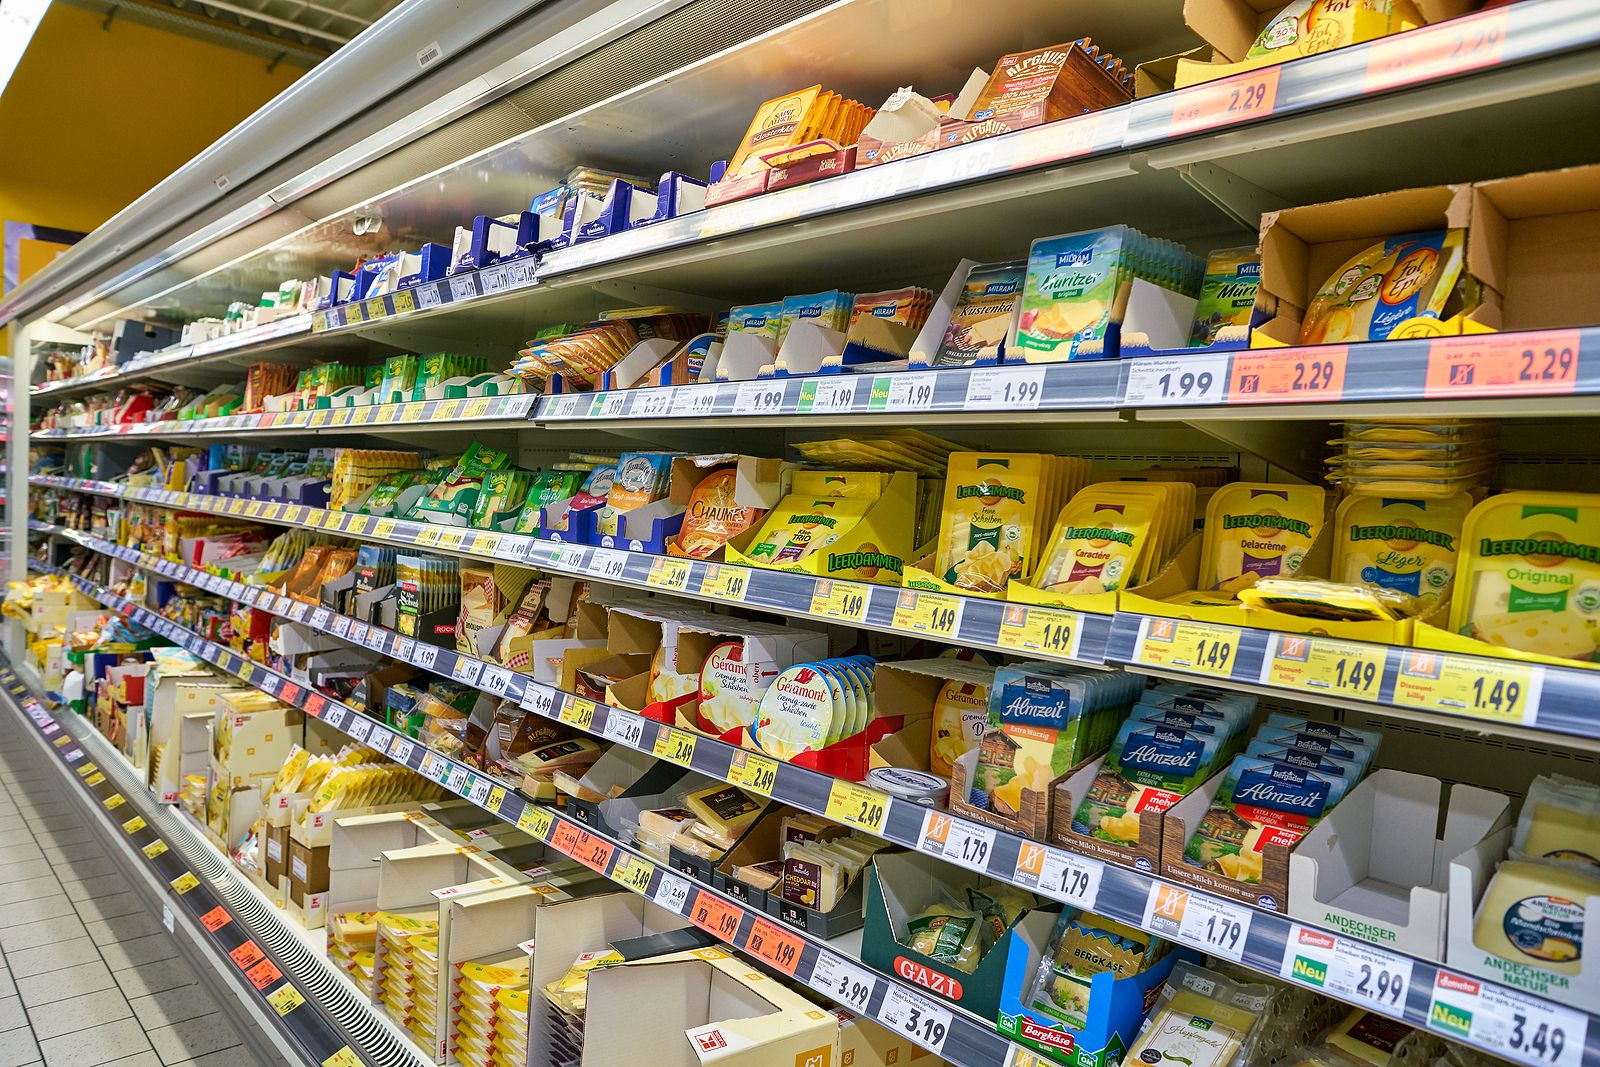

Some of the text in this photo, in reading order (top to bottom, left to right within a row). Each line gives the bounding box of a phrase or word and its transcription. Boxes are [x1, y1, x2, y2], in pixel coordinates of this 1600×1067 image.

[1228, 83, 1266, 113] 2.29
[1059, 253, 1090, 268] MILRAM
[1400, 254, 1430, 279] Fol
[987, 283, 1015, 294] MILRAM
[1390, 277, 1419, 298] Epi
[745, 319, 765, 328] MILRAM
[801, 308, 822, 319] MILRAM
[876, 308, 896, 318] MILRAM
[1292, 361, 1334, 390] 2.29
[1520, 348, 1572, 381] 2.29
[872, 383, 932, 407] Neu 1.99
[1004, 381, 1039, 403] 1.99
[1158, 372, 1214, 399] 1.99
[754, 391, 783, 410] 1.99
[800, 388, 852, 408] Neu 1.99
[787, 514, 837, 529] LEERDAMMER
[971, 512, 1003, 524] Scheiben
[981, 507, 996, 515] Feine
[1065, 526, 1137, 547] LEERDAMMER
[1223, 513, 1312, 539] LEERDAMMER
[792, 534, 812, 542] TRIO
[1240, 538, 1287, 553] Delacrème
[1351, 525, 1455, 552] LEERDAMMER
[606, 560, 623, 577] 1.99
[827, 552, 904, 577] LEERDAMMER
[727, 573, 744, 597] 1.49
[1506, 568, 1574, 587] Original
[842, 594, 863, 618] 1.49
[931, 606, 956, 633] 1.49
[1043, 623, 1071, 651] 1.49
[421, 651, 435, 665] 1.99
[1144, 643, 1173, 655] Discount-
[1149, 652, 1163, 663] billig
[1196, 639, 1231, 670] 1.49
[1273, 663, 1305, 675] Discount-
[1279, 672, 1296, 684] billig
[1335, 657, 1376, 692] 1.49
[489, 674, 506, 691] 1.99
[720, 680, 749, 694] Scheiben
[777, 675, 827, 703] Géramont
[1400, 681, 1436, 693] Discount-
[536, 695, 552, 716] 4.49
[1406, 689, 1426, 703] billig
[1473, 676, 1520, 714] 1.49
[577, 708, 592, 728] 2.49
[779, 702, 808, 718] Scheiben
[1002, 697, 1067, 724] Almzeit
[625, 724, 641, 744] 2.49
[675, 741, 693, 764] 2.49
[1122, 745, 1198, 769] Almzeit
[756, 767, 774, 791] 2.49
[1272, 770, 1305, 785] Bergader
[1236, 782, 1323, 808] Almzeit
[857, 802, 883, 828] 2.49
[535, 818, 548, 836] 2.99
[962, 836, 988, 865] 1.79
[1057, 833, 1078, 846] Unsere
[1078, 838, 1097, 851] Milch
[1097, 844, 1123, 858] kommt
[1122, 850, 1134, 859] aus
[632, 867, 650, 889] 3.49
[785, 873, 811, 887] CHEDDAR
[1016, 870, 1040, 882] LAKTOSE-
[1060, 867, 1090, 899] 1.79
[1167, 865, 1190, 880] Unsere
[1192, 871, 1213, 885] Milch
[1213, 877, 1241, 895] kommt
[1241, 889, 1255, 899] aus
[671, 887, 687, 900] 2.69
[718, 912, 737, 937] 1.99
[1152, 915, 1180, 930] LAKTOSE-
[1206, 914, 1242, 950] 1.79
[1324, 912, 1397, 943] ANDECHSER
[1301, 931, 1332, 948] demeter
[774, 942, 796, 967] 1.99
[1073, 947, 1124, 974] BERGKÄSE
[1294, 958, 1326, 981] Neu
[1483, 955, 1570, 989] ANDECHSER
[838, 975, 869, 1006] 3.99
[1356, 963, 1404, 1006] 2.99
[1439, 975, 1476, 993] demeter
[1502, 972, 1549, 995] NATUR
[904, 1007, 946, 1046] 3.19
[1432, 1003, 1473, 1031] Neu
[1024, 1024, 1071, 1047] Bergkäse
[1508, 1013, 1566, 1063] 3.49
